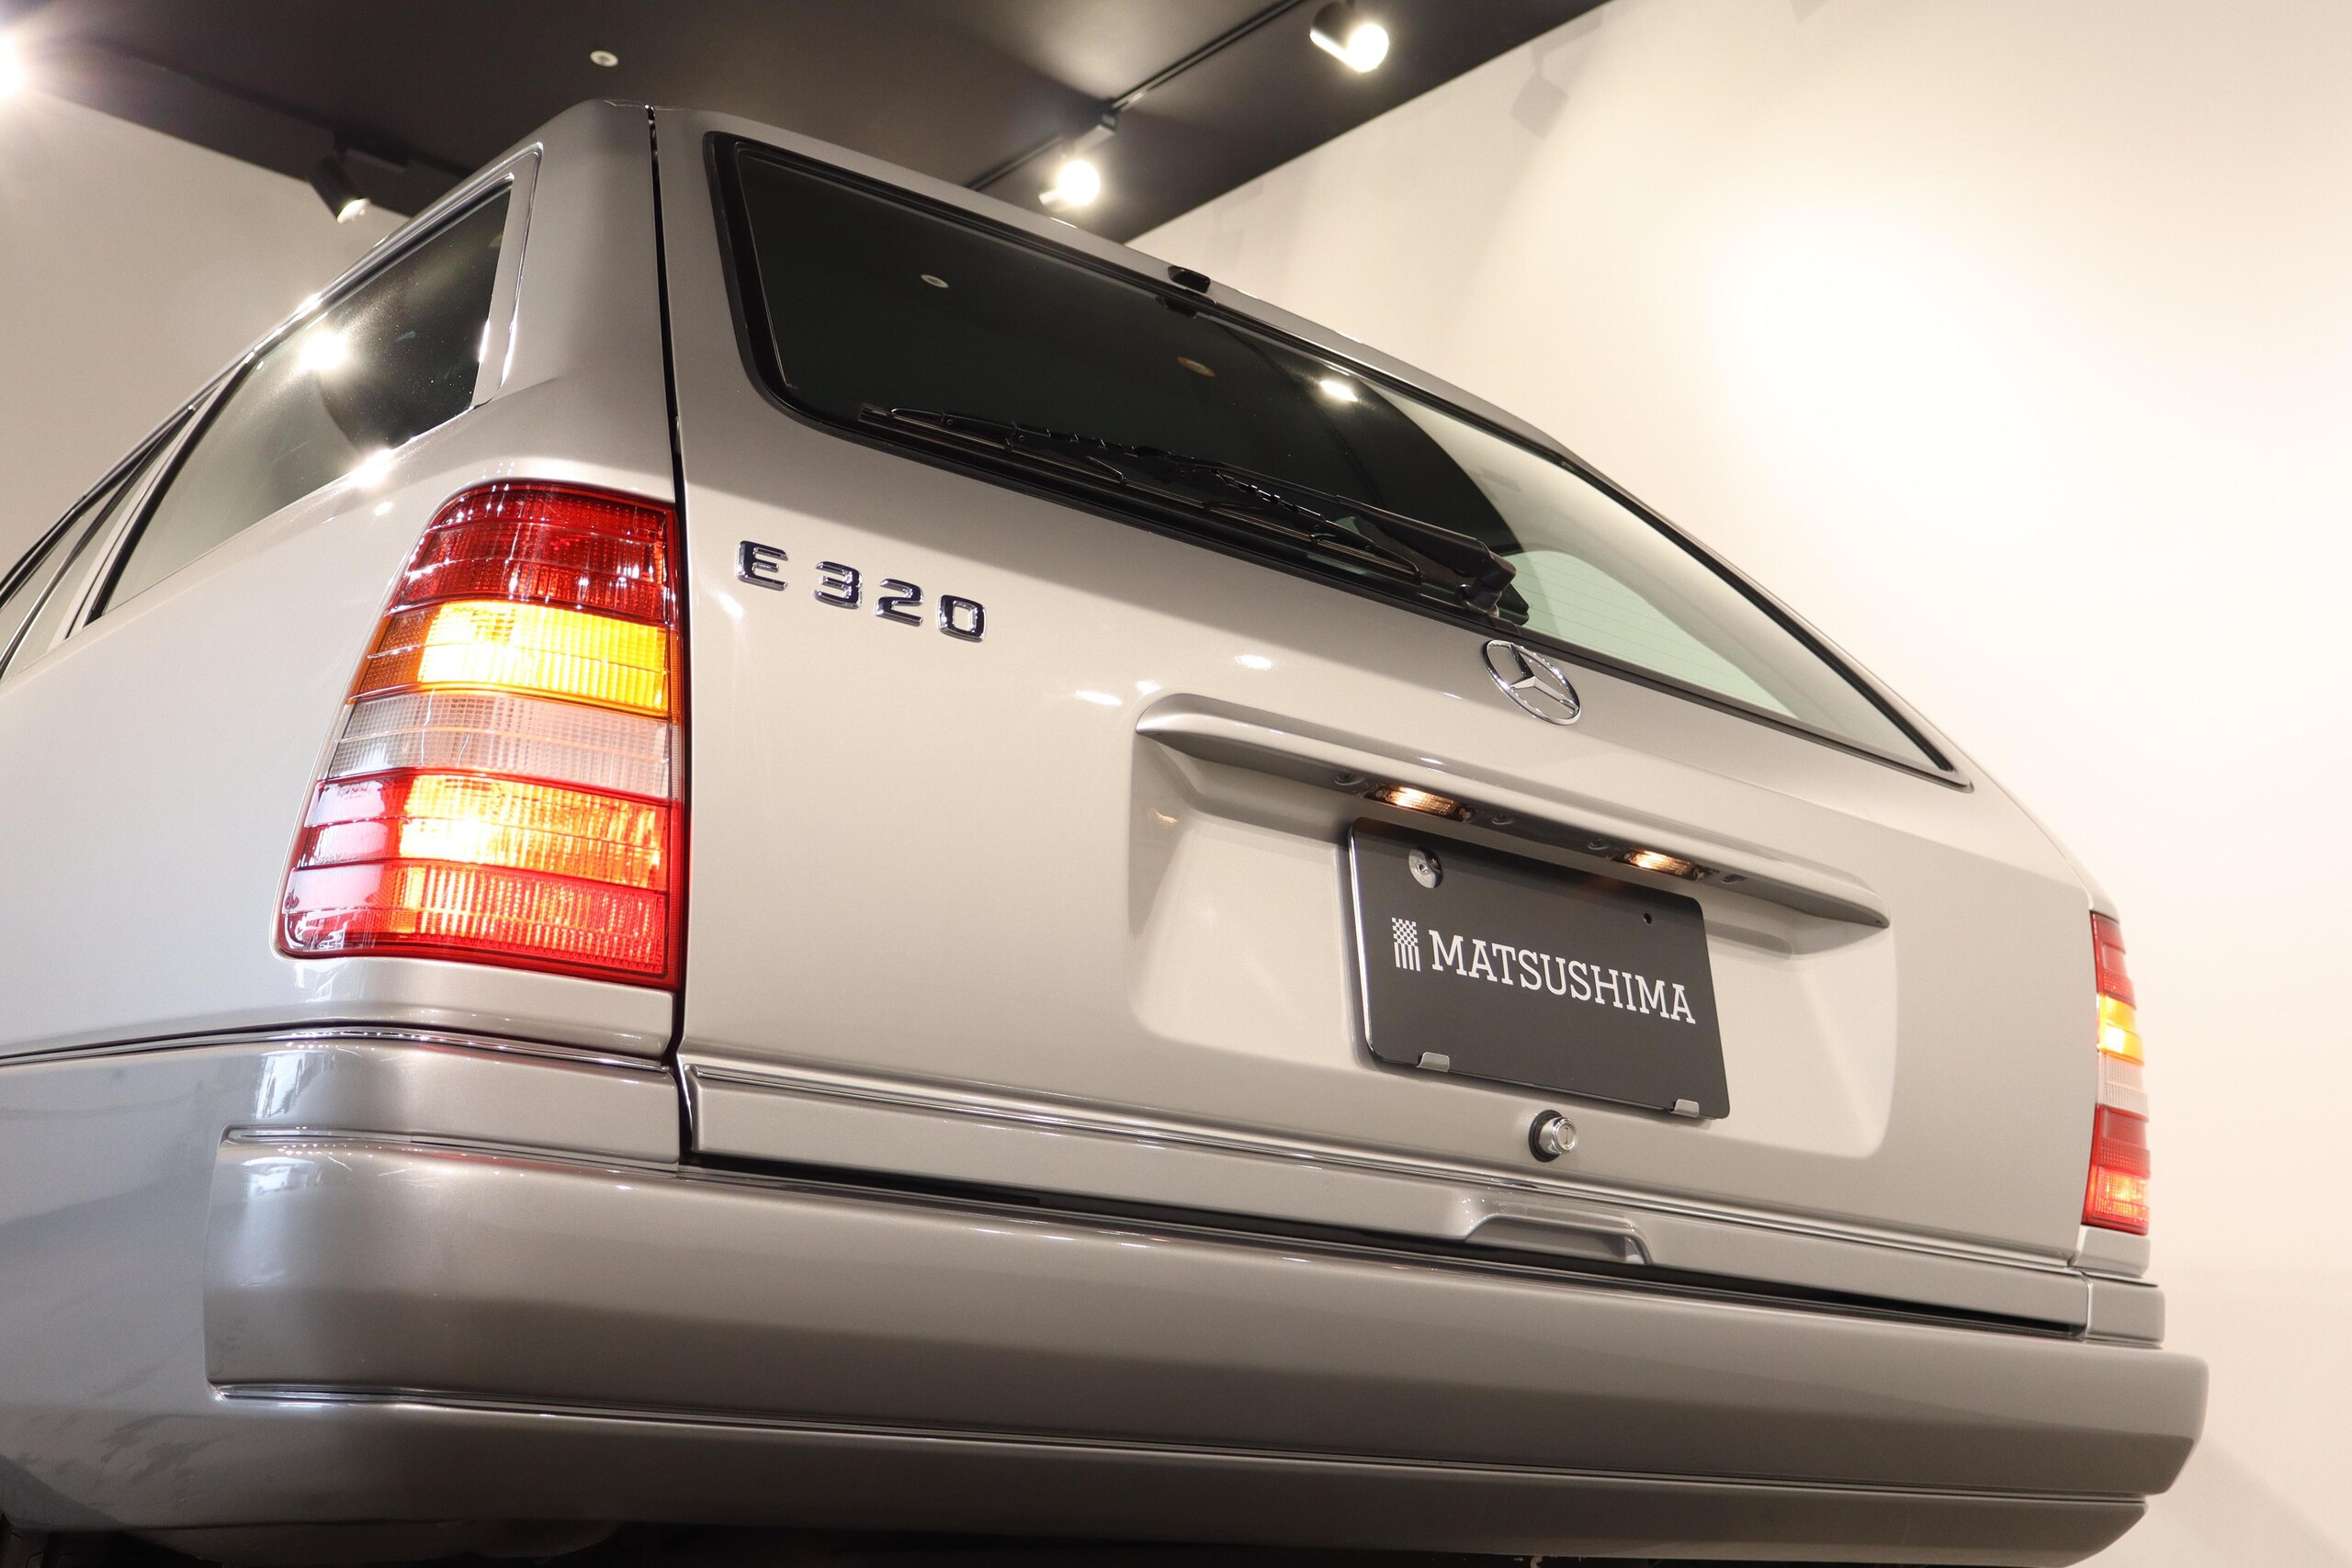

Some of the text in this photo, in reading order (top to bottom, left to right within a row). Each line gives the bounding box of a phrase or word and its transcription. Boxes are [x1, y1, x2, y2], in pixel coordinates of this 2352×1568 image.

[736, 540, 987, 643] E 320
[1428, 929, 1696, 1024] MATSUSHIMA
